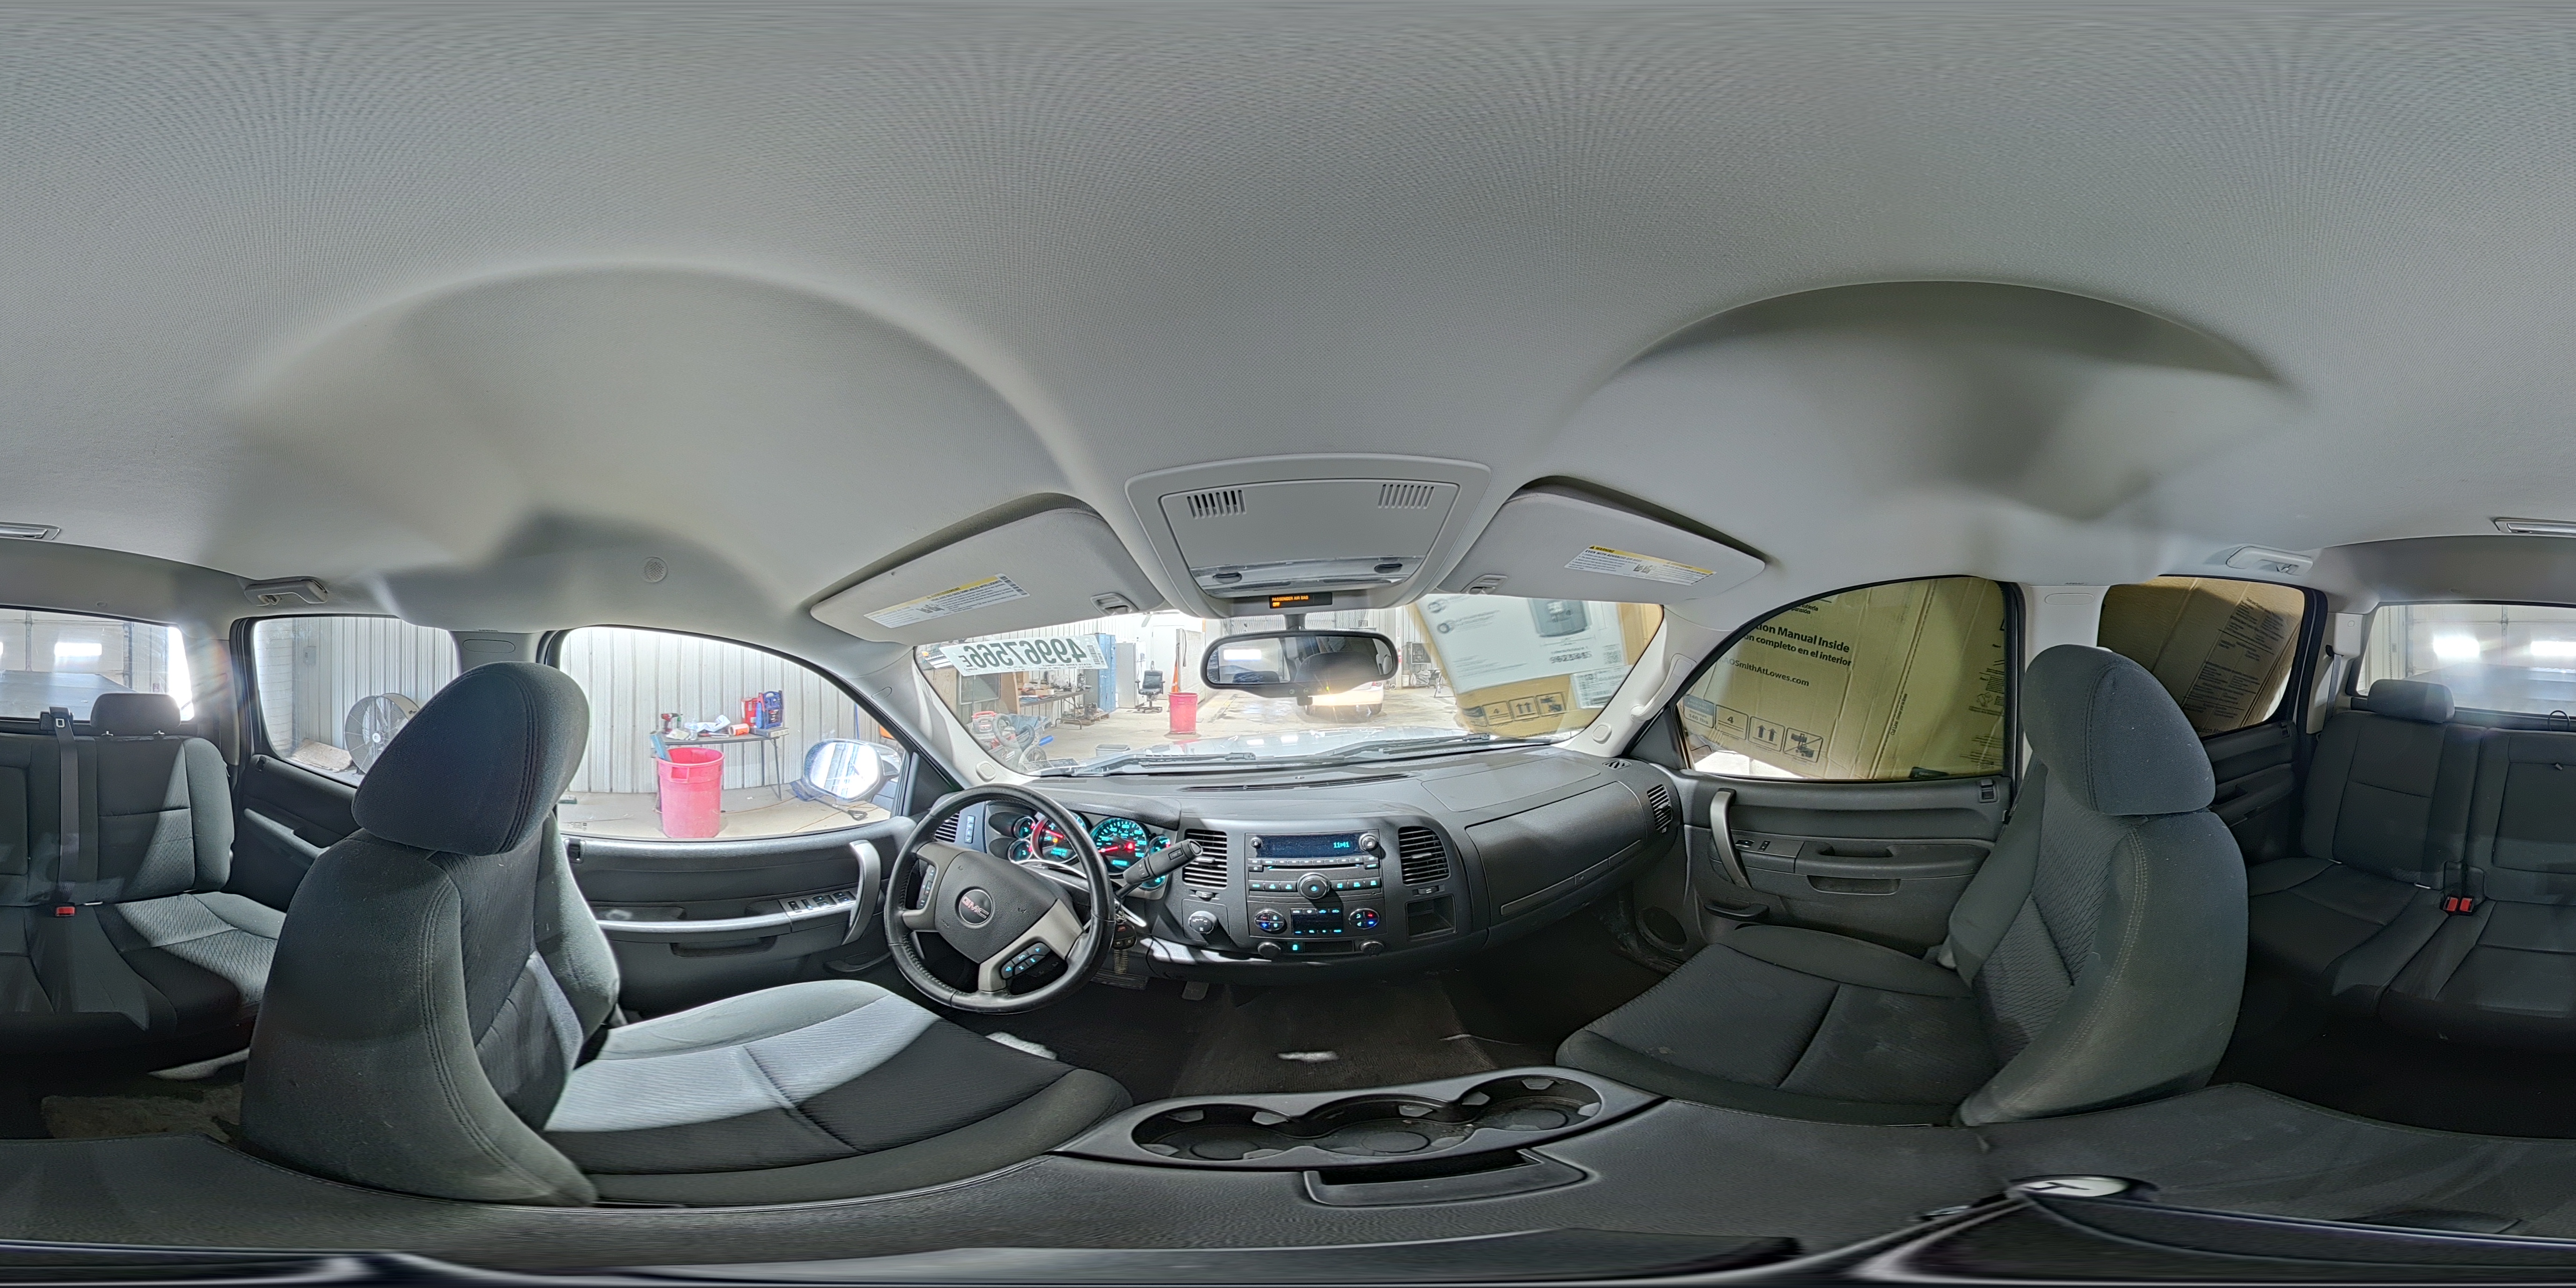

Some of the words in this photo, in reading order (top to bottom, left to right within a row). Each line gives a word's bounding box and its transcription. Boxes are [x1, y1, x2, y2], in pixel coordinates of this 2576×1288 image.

[1756, 636, 1796, 652] completo
[1820, 651, 1852, 666] interior
[1778, 627, 1817, 644] Manual
[1819, 637, 1850, 653] Inside
[962, 896, 989, 919] GMC
